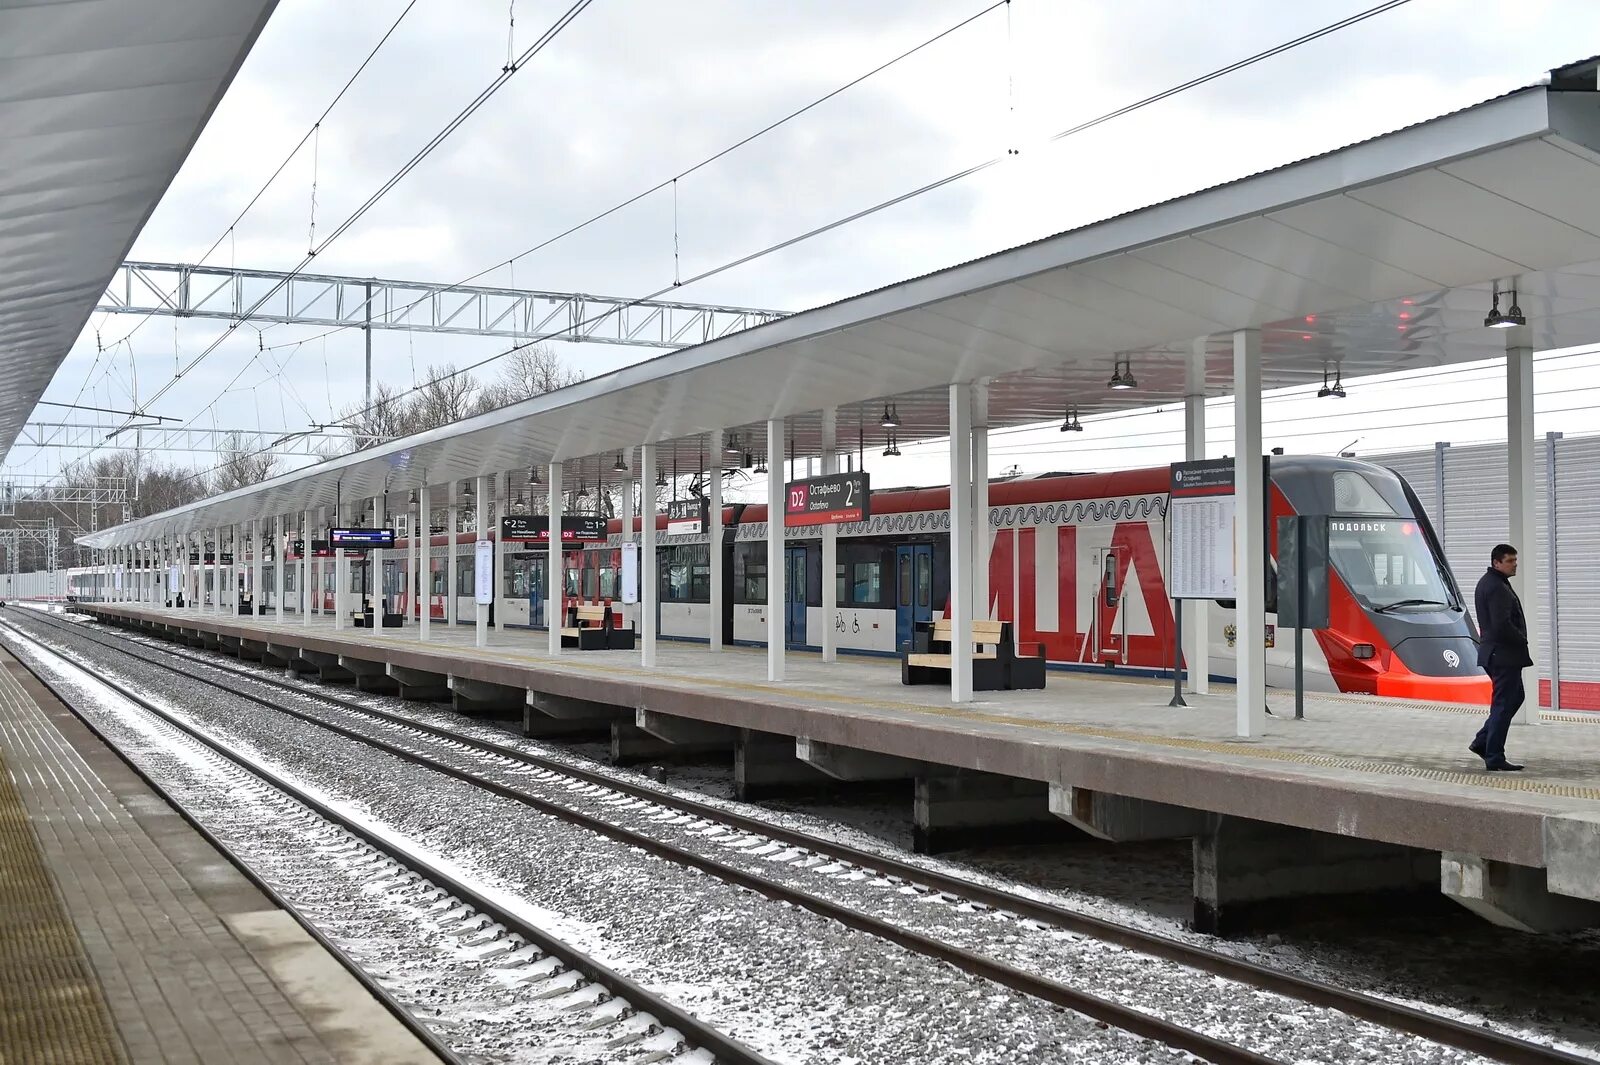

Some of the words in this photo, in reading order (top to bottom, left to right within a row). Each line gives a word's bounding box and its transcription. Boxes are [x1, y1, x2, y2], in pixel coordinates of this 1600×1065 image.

[810, 483, 840, 496] Остафьево
[845, 480, 853, 506] 2
[791, 490, 804, 507] D2
[511, 519, 517, 528] 2
[595, 521, 599, 529] 1
[1332, 522, 1386, 532] ПОДОЛЬСК
